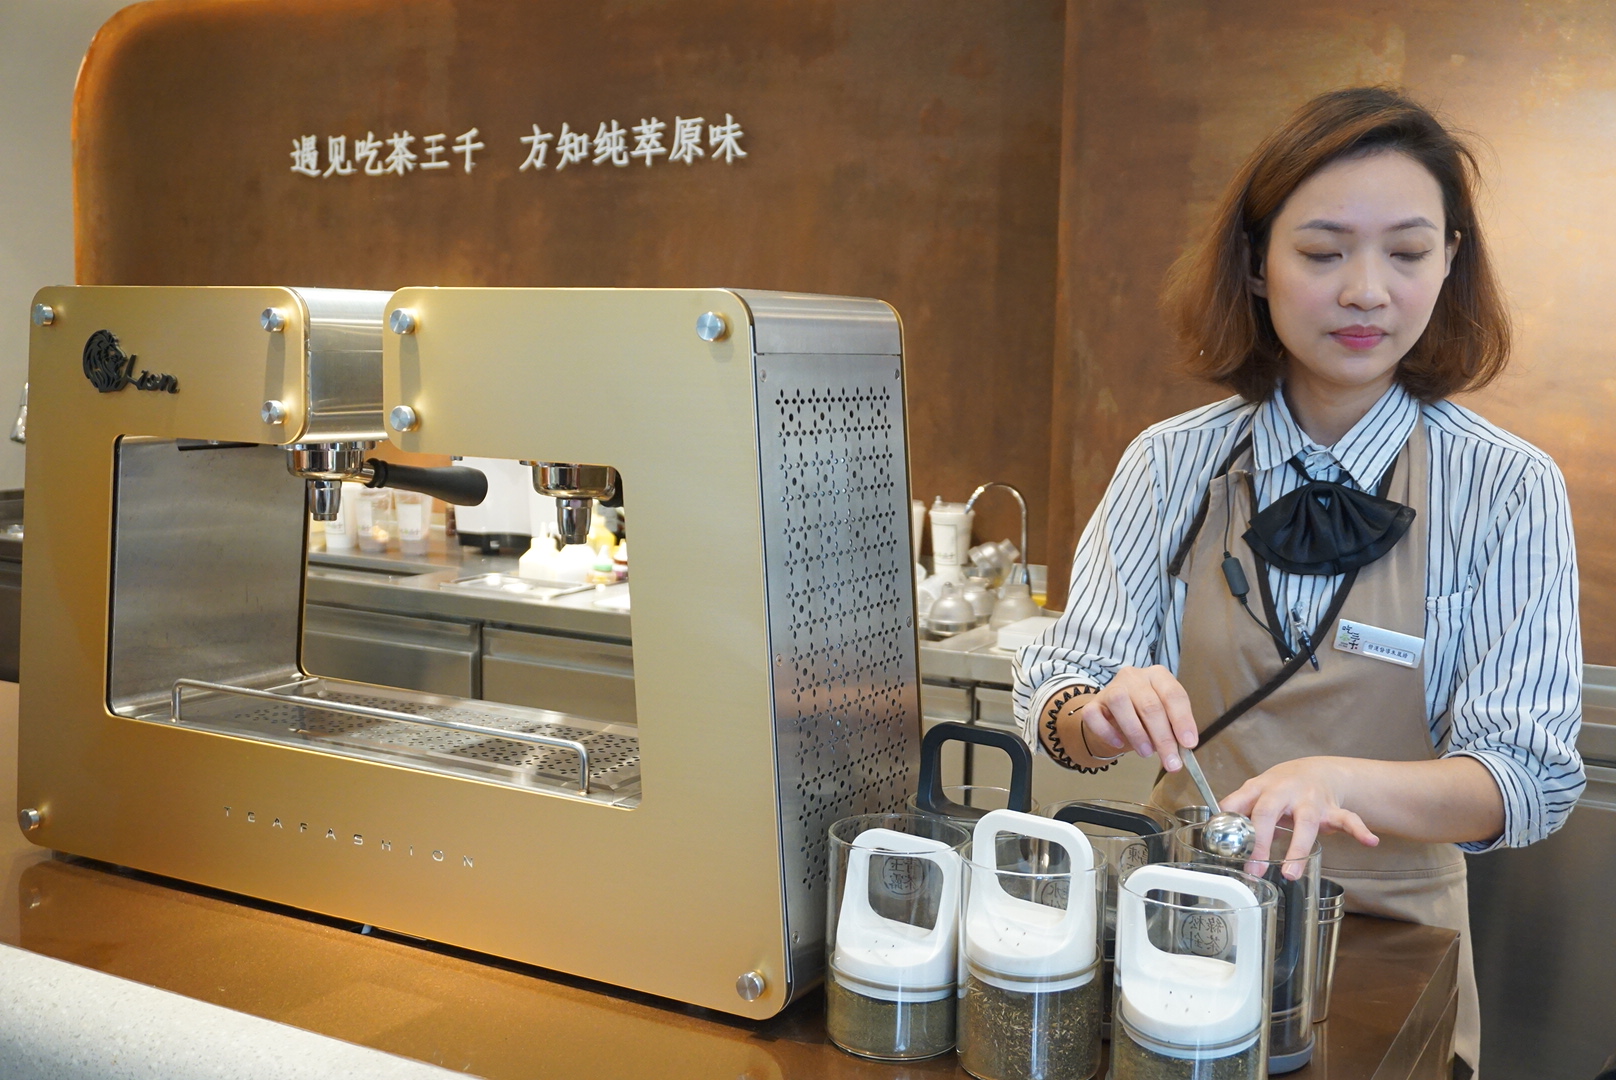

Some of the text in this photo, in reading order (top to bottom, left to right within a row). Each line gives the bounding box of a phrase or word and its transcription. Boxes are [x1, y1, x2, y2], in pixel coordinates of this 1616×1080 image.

[518, 112, 748, 172] 方知纯萃原味
[114, 354, 180, 393] Lion
[223, 806, 475, 868] TEAFASHION
